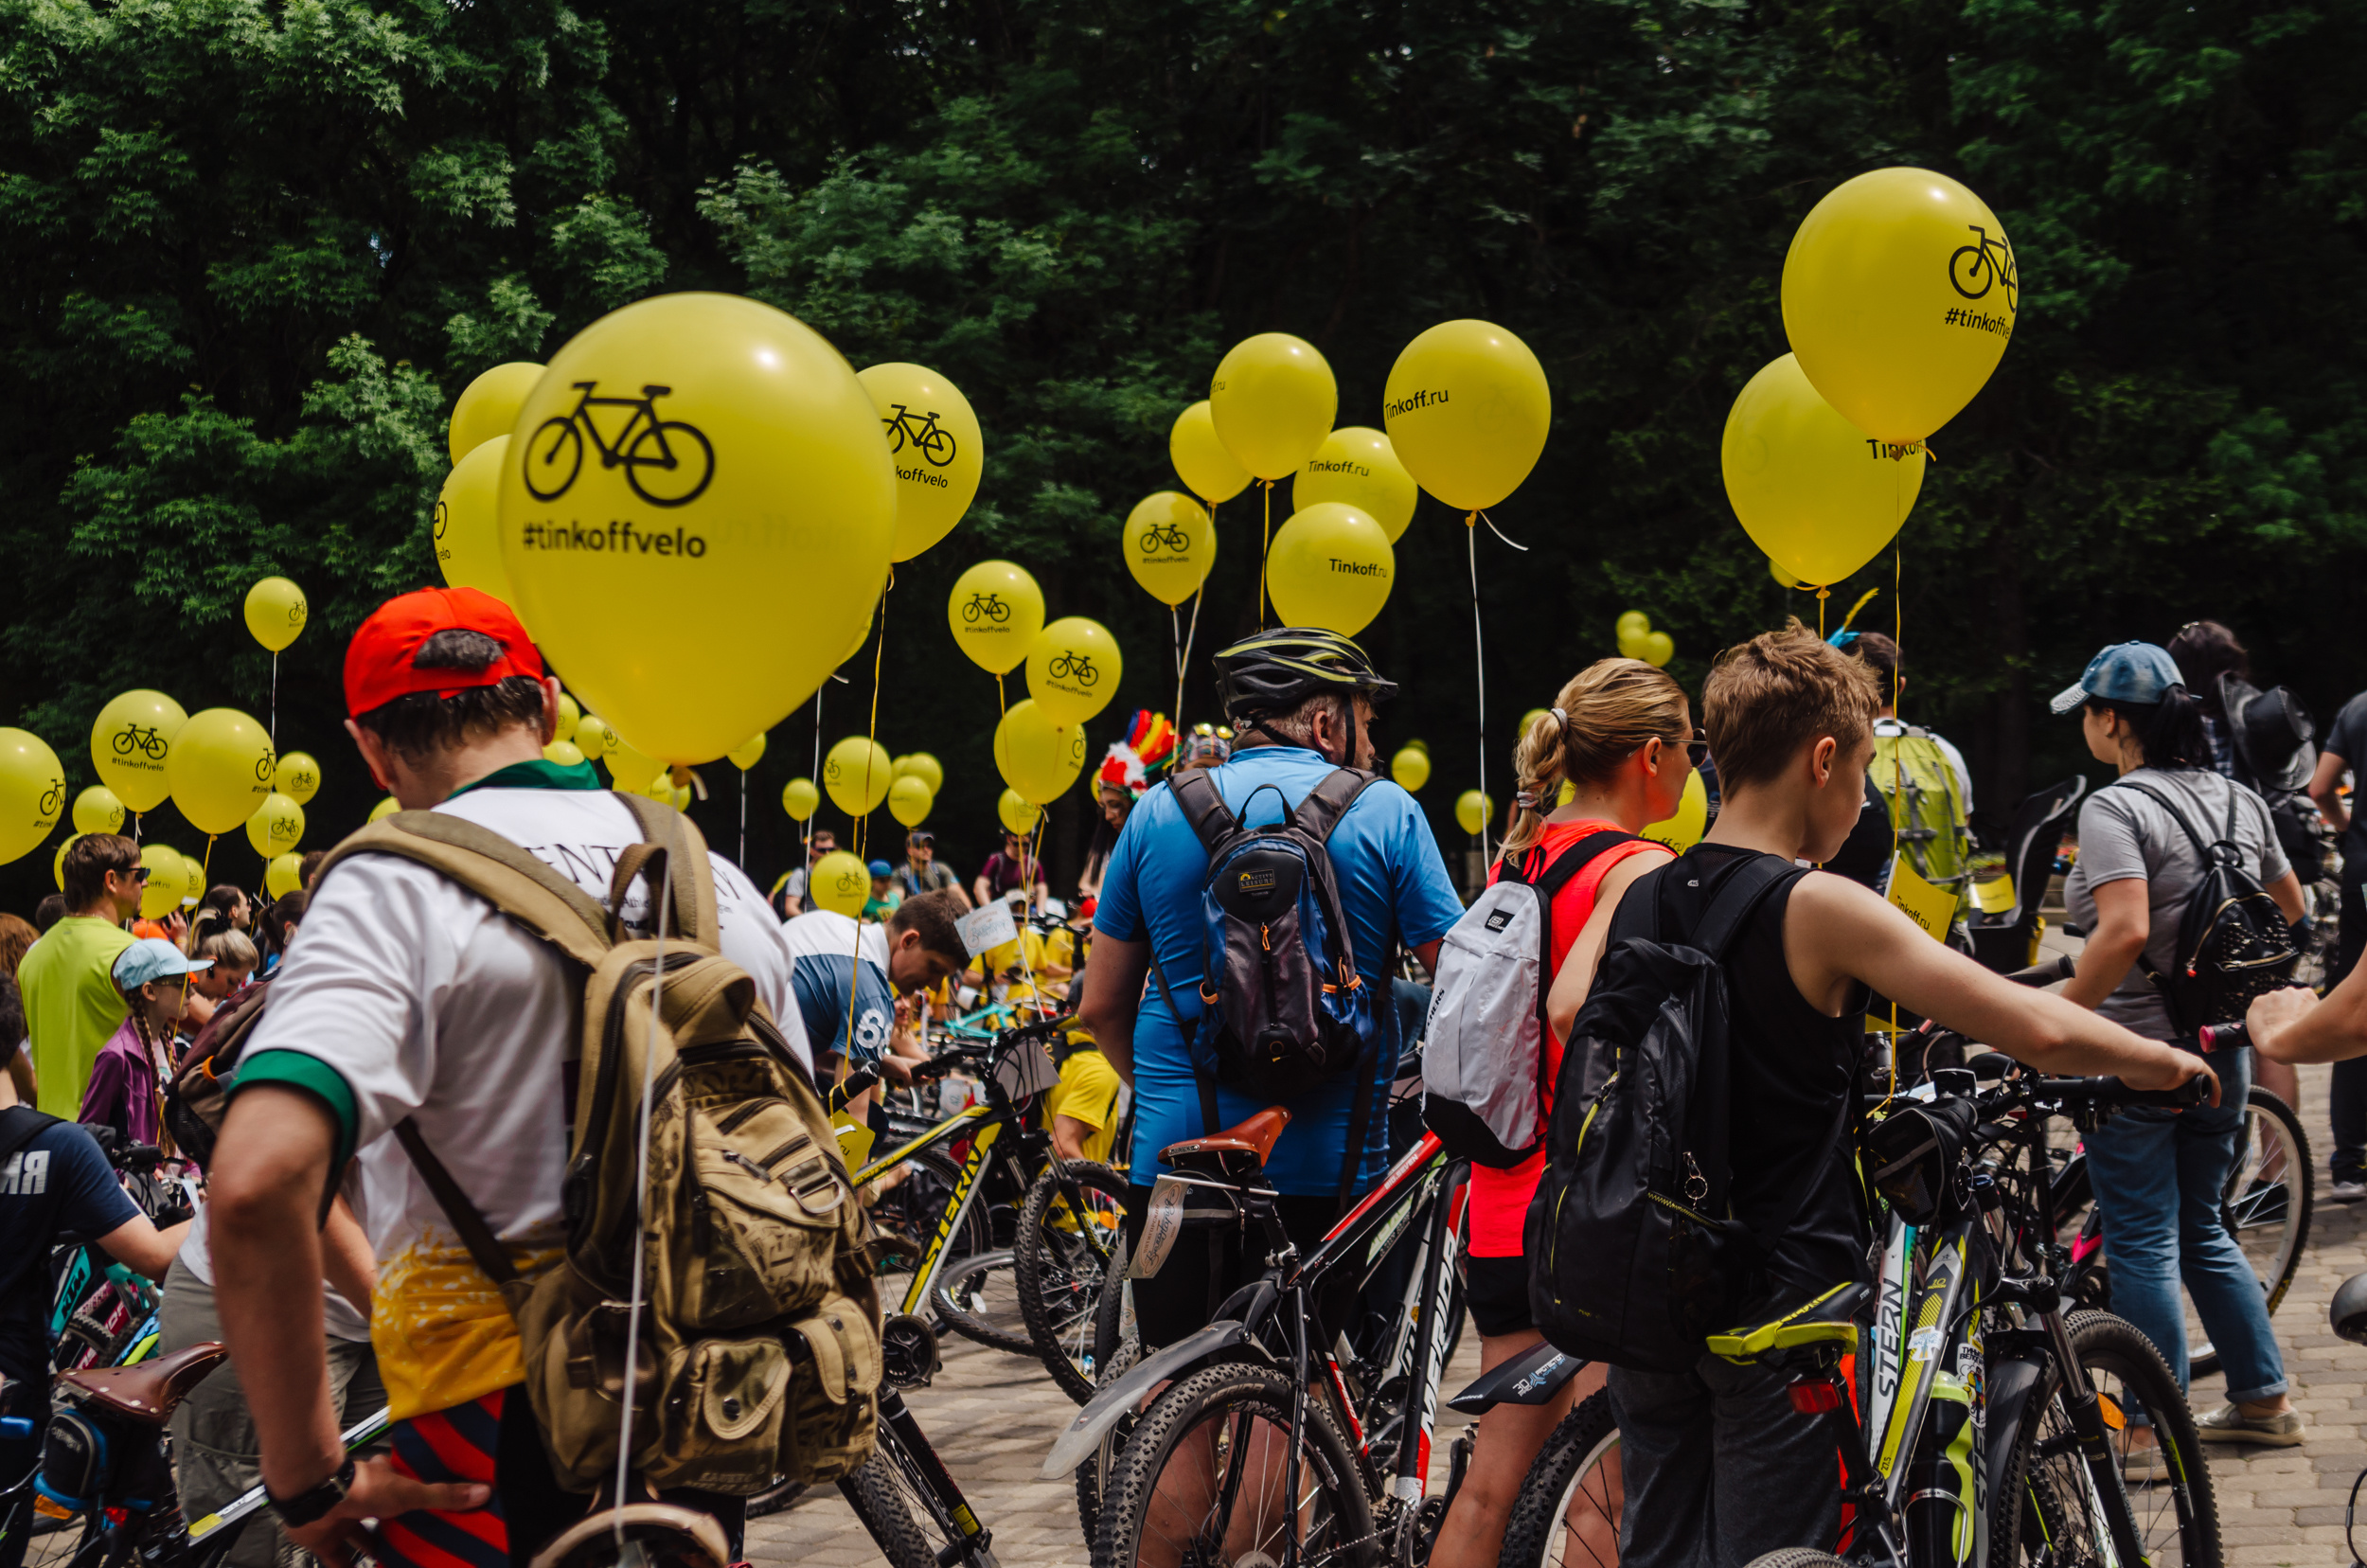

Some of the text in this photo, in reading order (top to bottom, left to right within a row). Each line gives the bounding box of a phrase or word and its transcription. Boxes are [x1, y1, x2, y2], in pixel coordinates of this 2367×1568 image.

[1385, 389, 1450, 420] Tinkoff.ru
[1308, 460, 1370, 477] Tinkoff.ru
[523, 520, 706, 559] #tinkoffvelo
[1045, 679, 1093, 698] #tinkoffvelo
[112, 757, 165, 772] #tinkoffvelo
[61, 1267, 86, 1320] KTM
[1420, 1226, 1458, 1445] MERIDA
[1878, 1277, 1903, 1397] STERN
